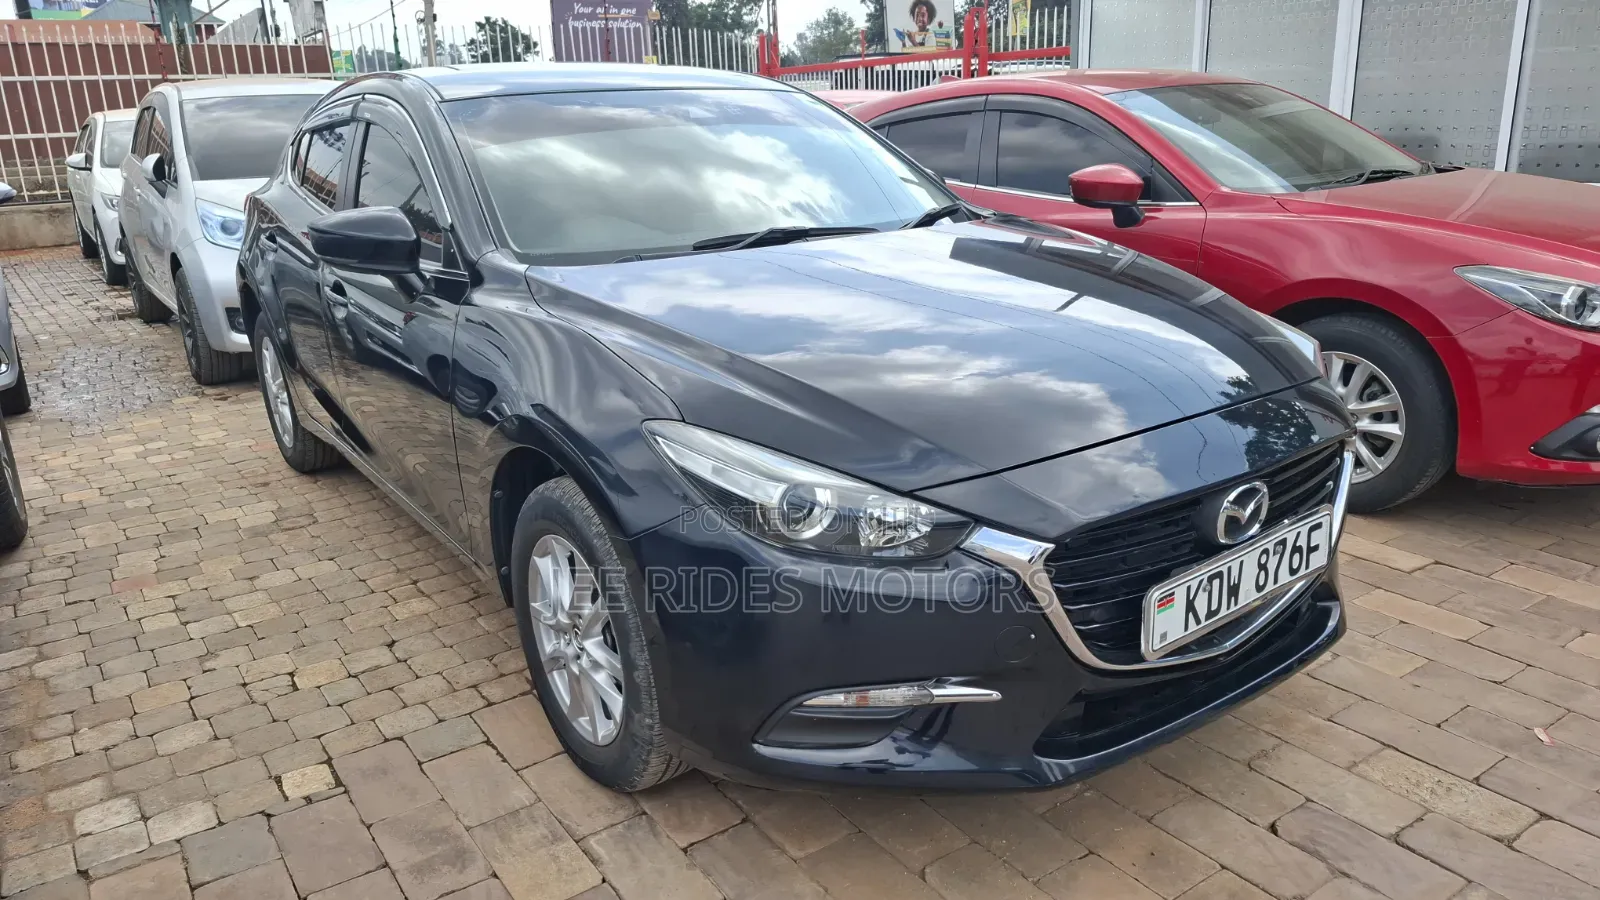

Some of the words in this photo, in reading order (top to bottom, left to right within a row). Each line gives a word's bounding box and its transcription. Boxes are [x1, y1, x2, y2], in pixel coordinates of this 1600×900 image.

[574, 2, 593, 14] Your
[610, 5, 618, 14] in
[621, 6, 636, 15] one
[568, 16, 605, 28] business
[608, 18, 642, 28] solution
[1184, 560, 1244, 632] KDW
[1255, 521, 1323, 594] 876F
